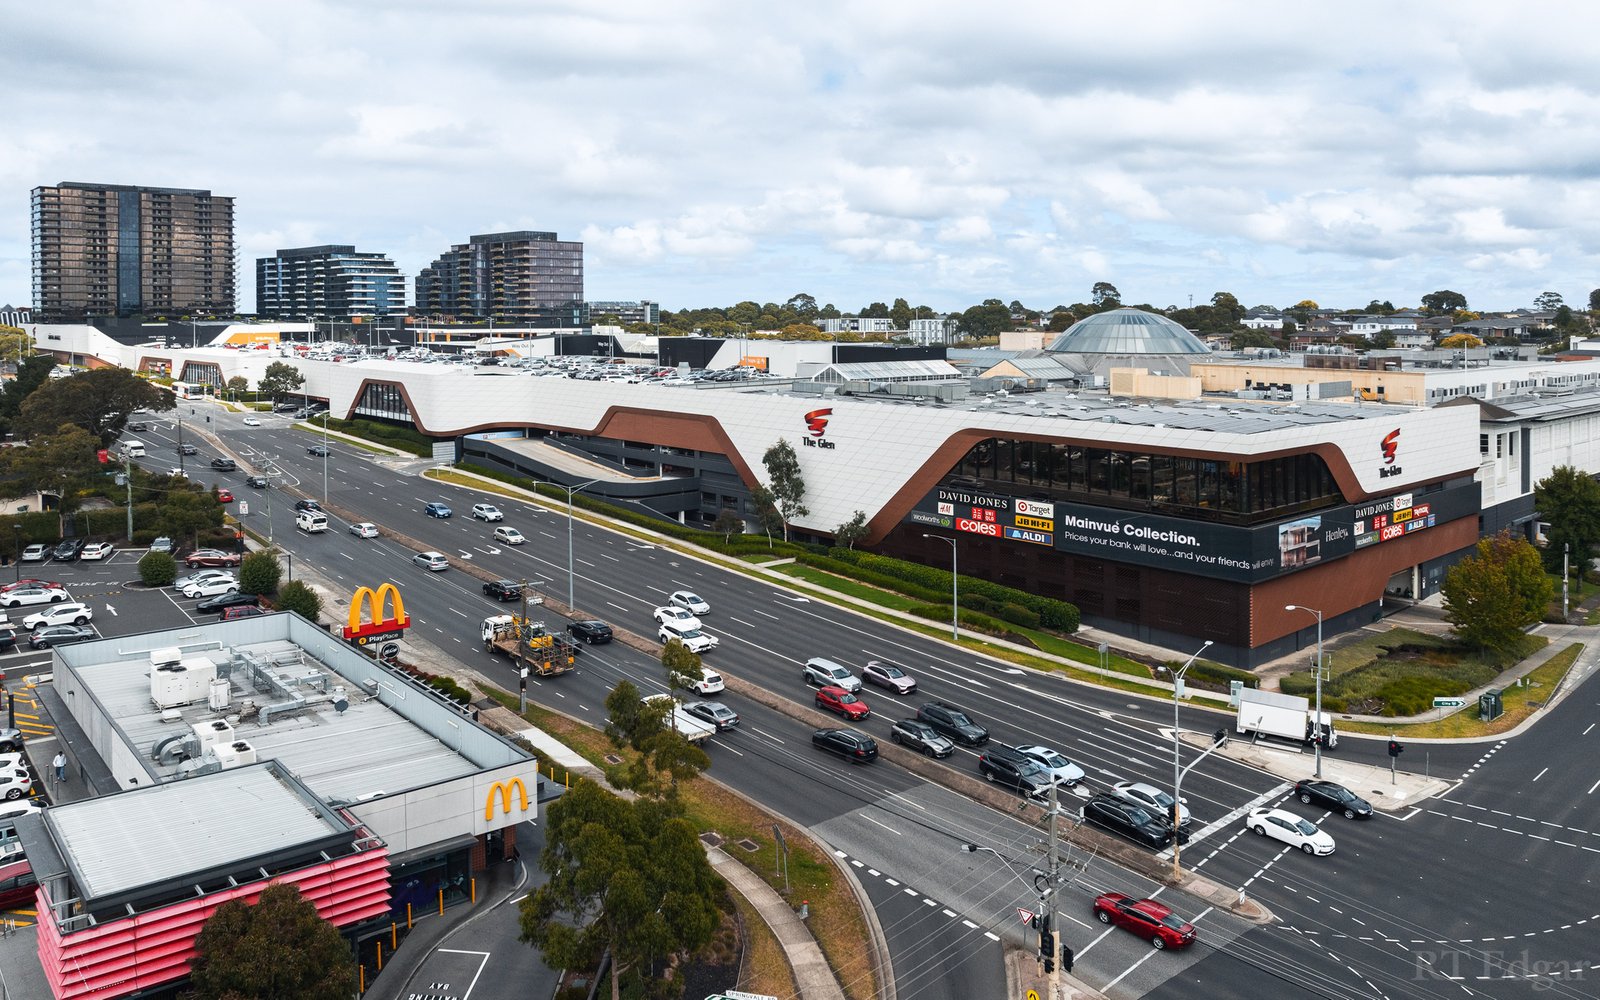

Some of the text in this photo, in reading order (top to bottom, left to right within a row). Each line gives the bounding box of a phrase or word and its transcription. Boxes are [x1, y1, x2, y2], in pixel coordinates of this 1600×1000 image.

[802, 436, 835, 449] The Glen
[939, 490, 1008, 509] DAVID JONES
[1028, 503, 1050, 515] Target
[1355, 501, 1394, 519] DAVID JONES
[913, 514, 940, 524] woolworths
[1017, 517, 1050, 529] JB HI-FI
[1413, 520, 1424, 529] ALDI
[960, 519, 997, 536] coles
[1383, 525, 1402, 539] coles
[1022, 531, 1045, 543] ALDI
[1124, 524, 1201, 546] Collection.
[1064, 531, 1089, 542] Prices
[1090, 537, 1107, 545] your
[1109, 538, 1131, 549] bank
[1133, 543, 1146, 552] will
[1195, 554, 1216, 563] your
[1218, 556, 1250, 570] friends
[369, 633, 399, 643] PlayPlace
[429, 982, 450, 990] BAY
